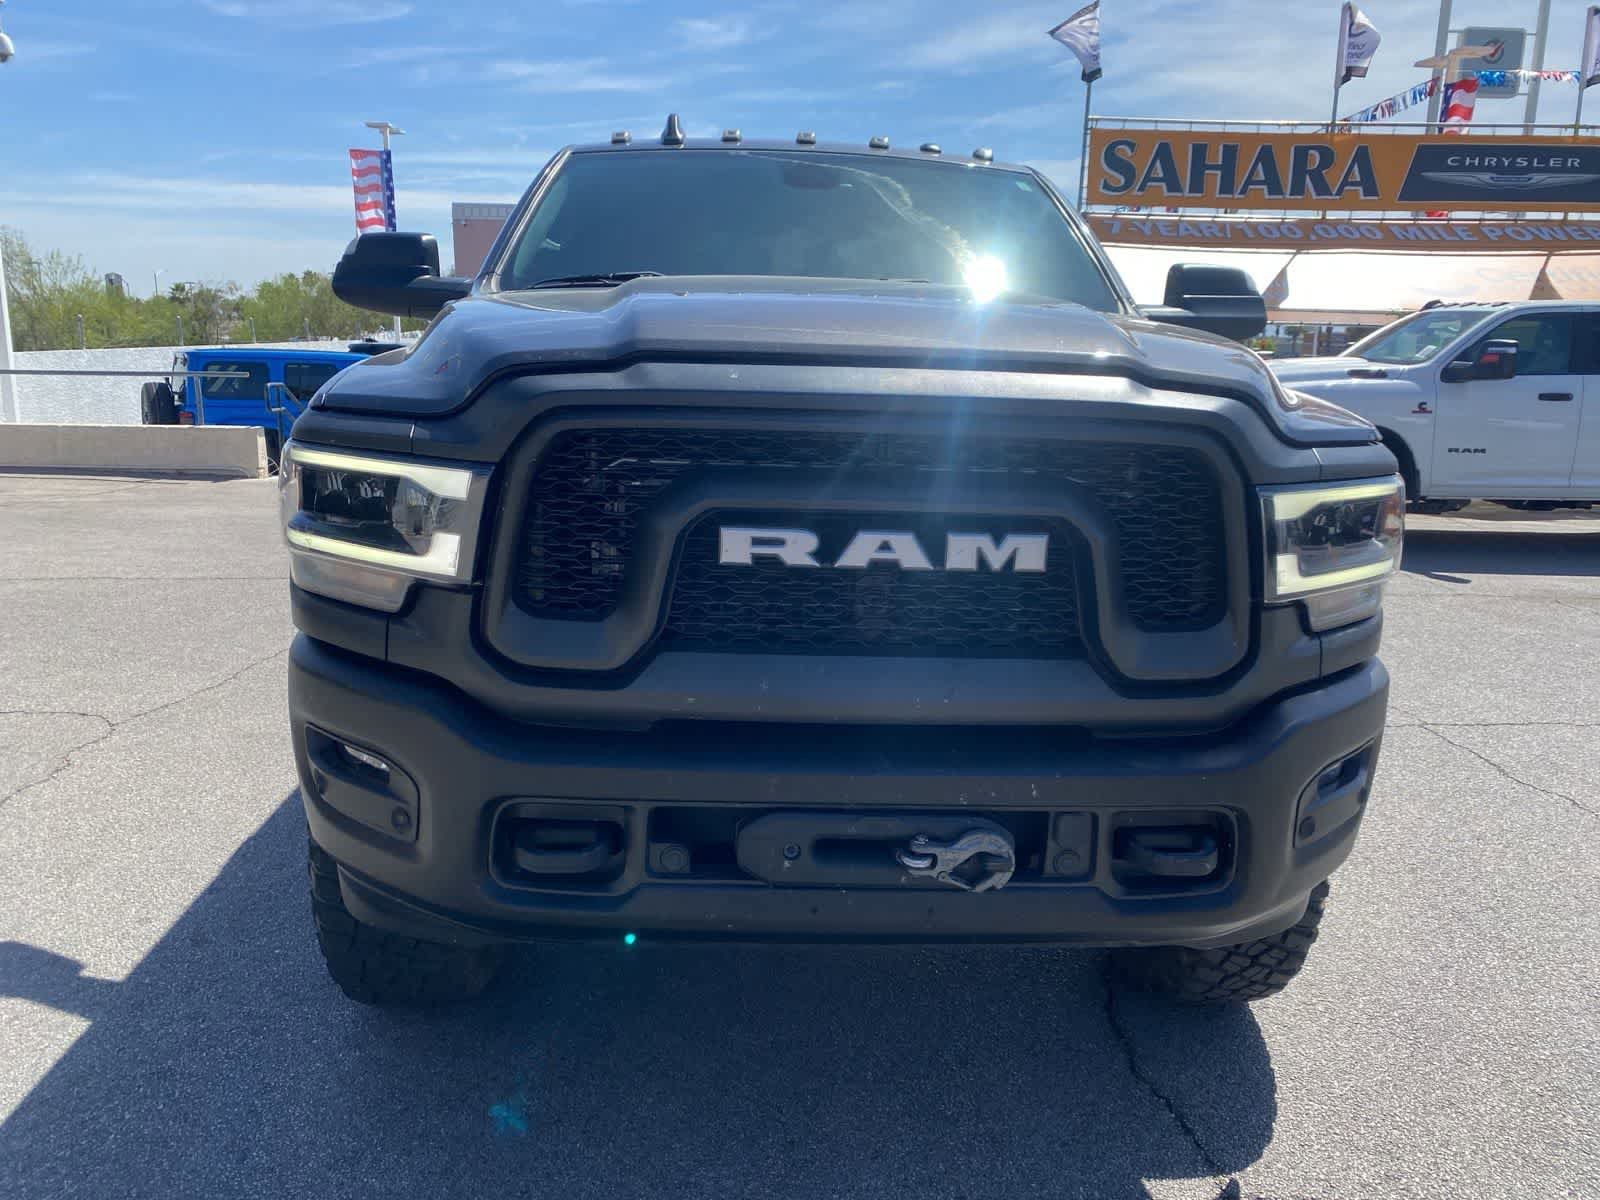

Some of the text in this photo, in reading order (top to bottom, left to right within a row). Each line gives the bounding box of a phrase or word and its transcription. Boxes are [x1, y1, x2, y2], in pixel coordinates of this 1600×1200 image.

[1100, 138, 1380, 200] SAHARA
[1447, 156, 1581, 168] CHRYSLER
[1388, 224, 1479, 241] MILE
[719, 526, 1049, 573] RAM
